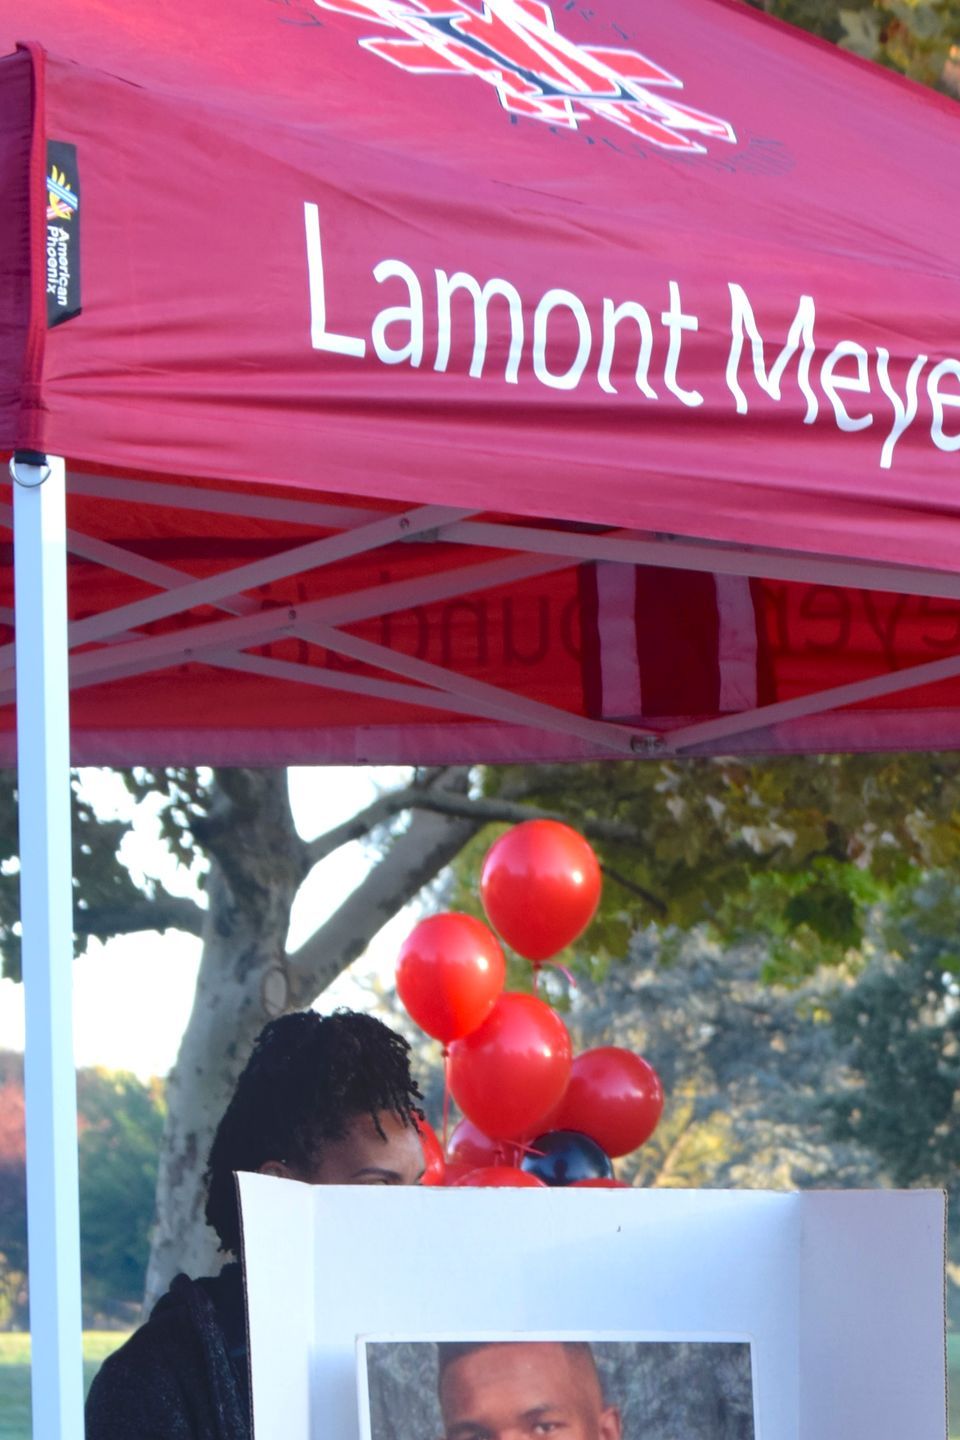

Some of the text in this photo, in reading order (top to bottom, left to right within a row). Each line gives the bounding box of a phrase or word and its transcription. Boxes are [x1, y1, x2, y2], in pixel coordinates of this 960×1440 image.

[46, 225, 60, 294] Phoenix
[58, 227, 70, 306] American
[304, 202, 704, 409] Lamont
